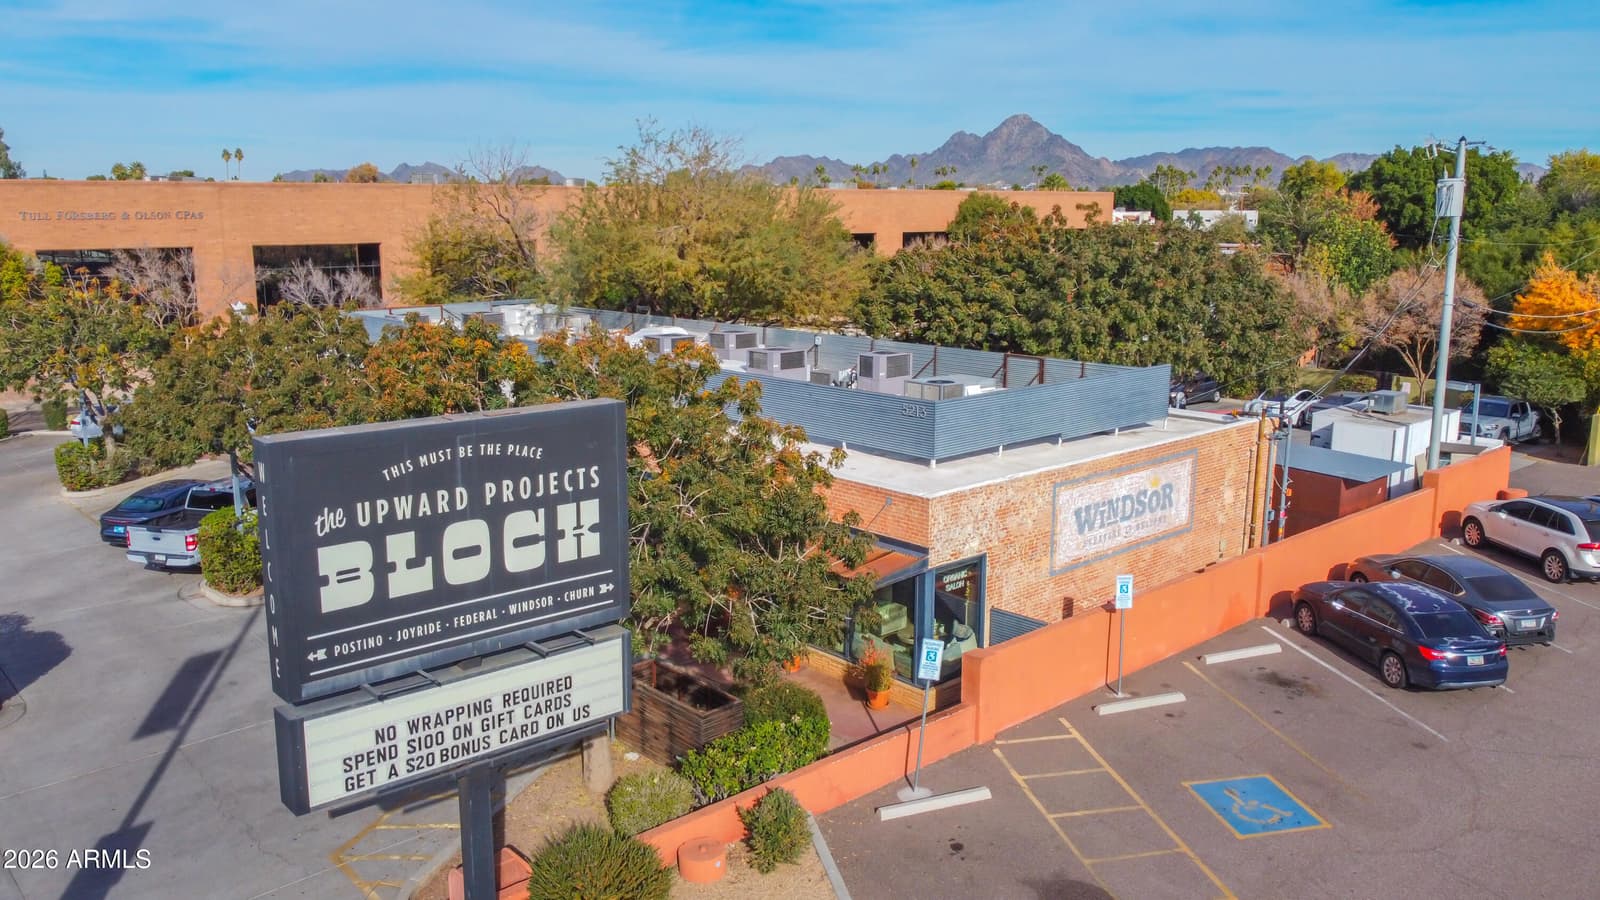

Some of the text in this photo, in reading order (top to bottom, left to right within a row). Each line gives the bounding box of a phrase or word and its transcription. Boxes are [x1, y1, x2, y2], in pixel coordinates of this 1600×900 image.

[382, 444, 543, 481] THIS MUST BE THE PLACE
[314, 466, 600, 537] the UPWARD PROJECTS
[256, 461, 280, 678] WELCOME
[317, 498, 601, 614] BLOCK
[334, 586, 594, 656] POSTINO JOYRIDE FEDERAL WINDSOR CHURN
[342, 744, 398, 774] SPEND
[452, 721, 474, 740] ON
[481, 710, 513, 733] GIFT
[524, 694, 572, 720] CARDS
[374, 675, 573, 745] NO WRAPPING REQUIRED
[344, 775, 376, 792] GET
[388, 763, 399, 779] A
[440, 736, 490, 763] BONUS
[499, 720, 539, 745] CARD
[546, 714, 564, 730] ON
[573, 704, 591, 722] US
